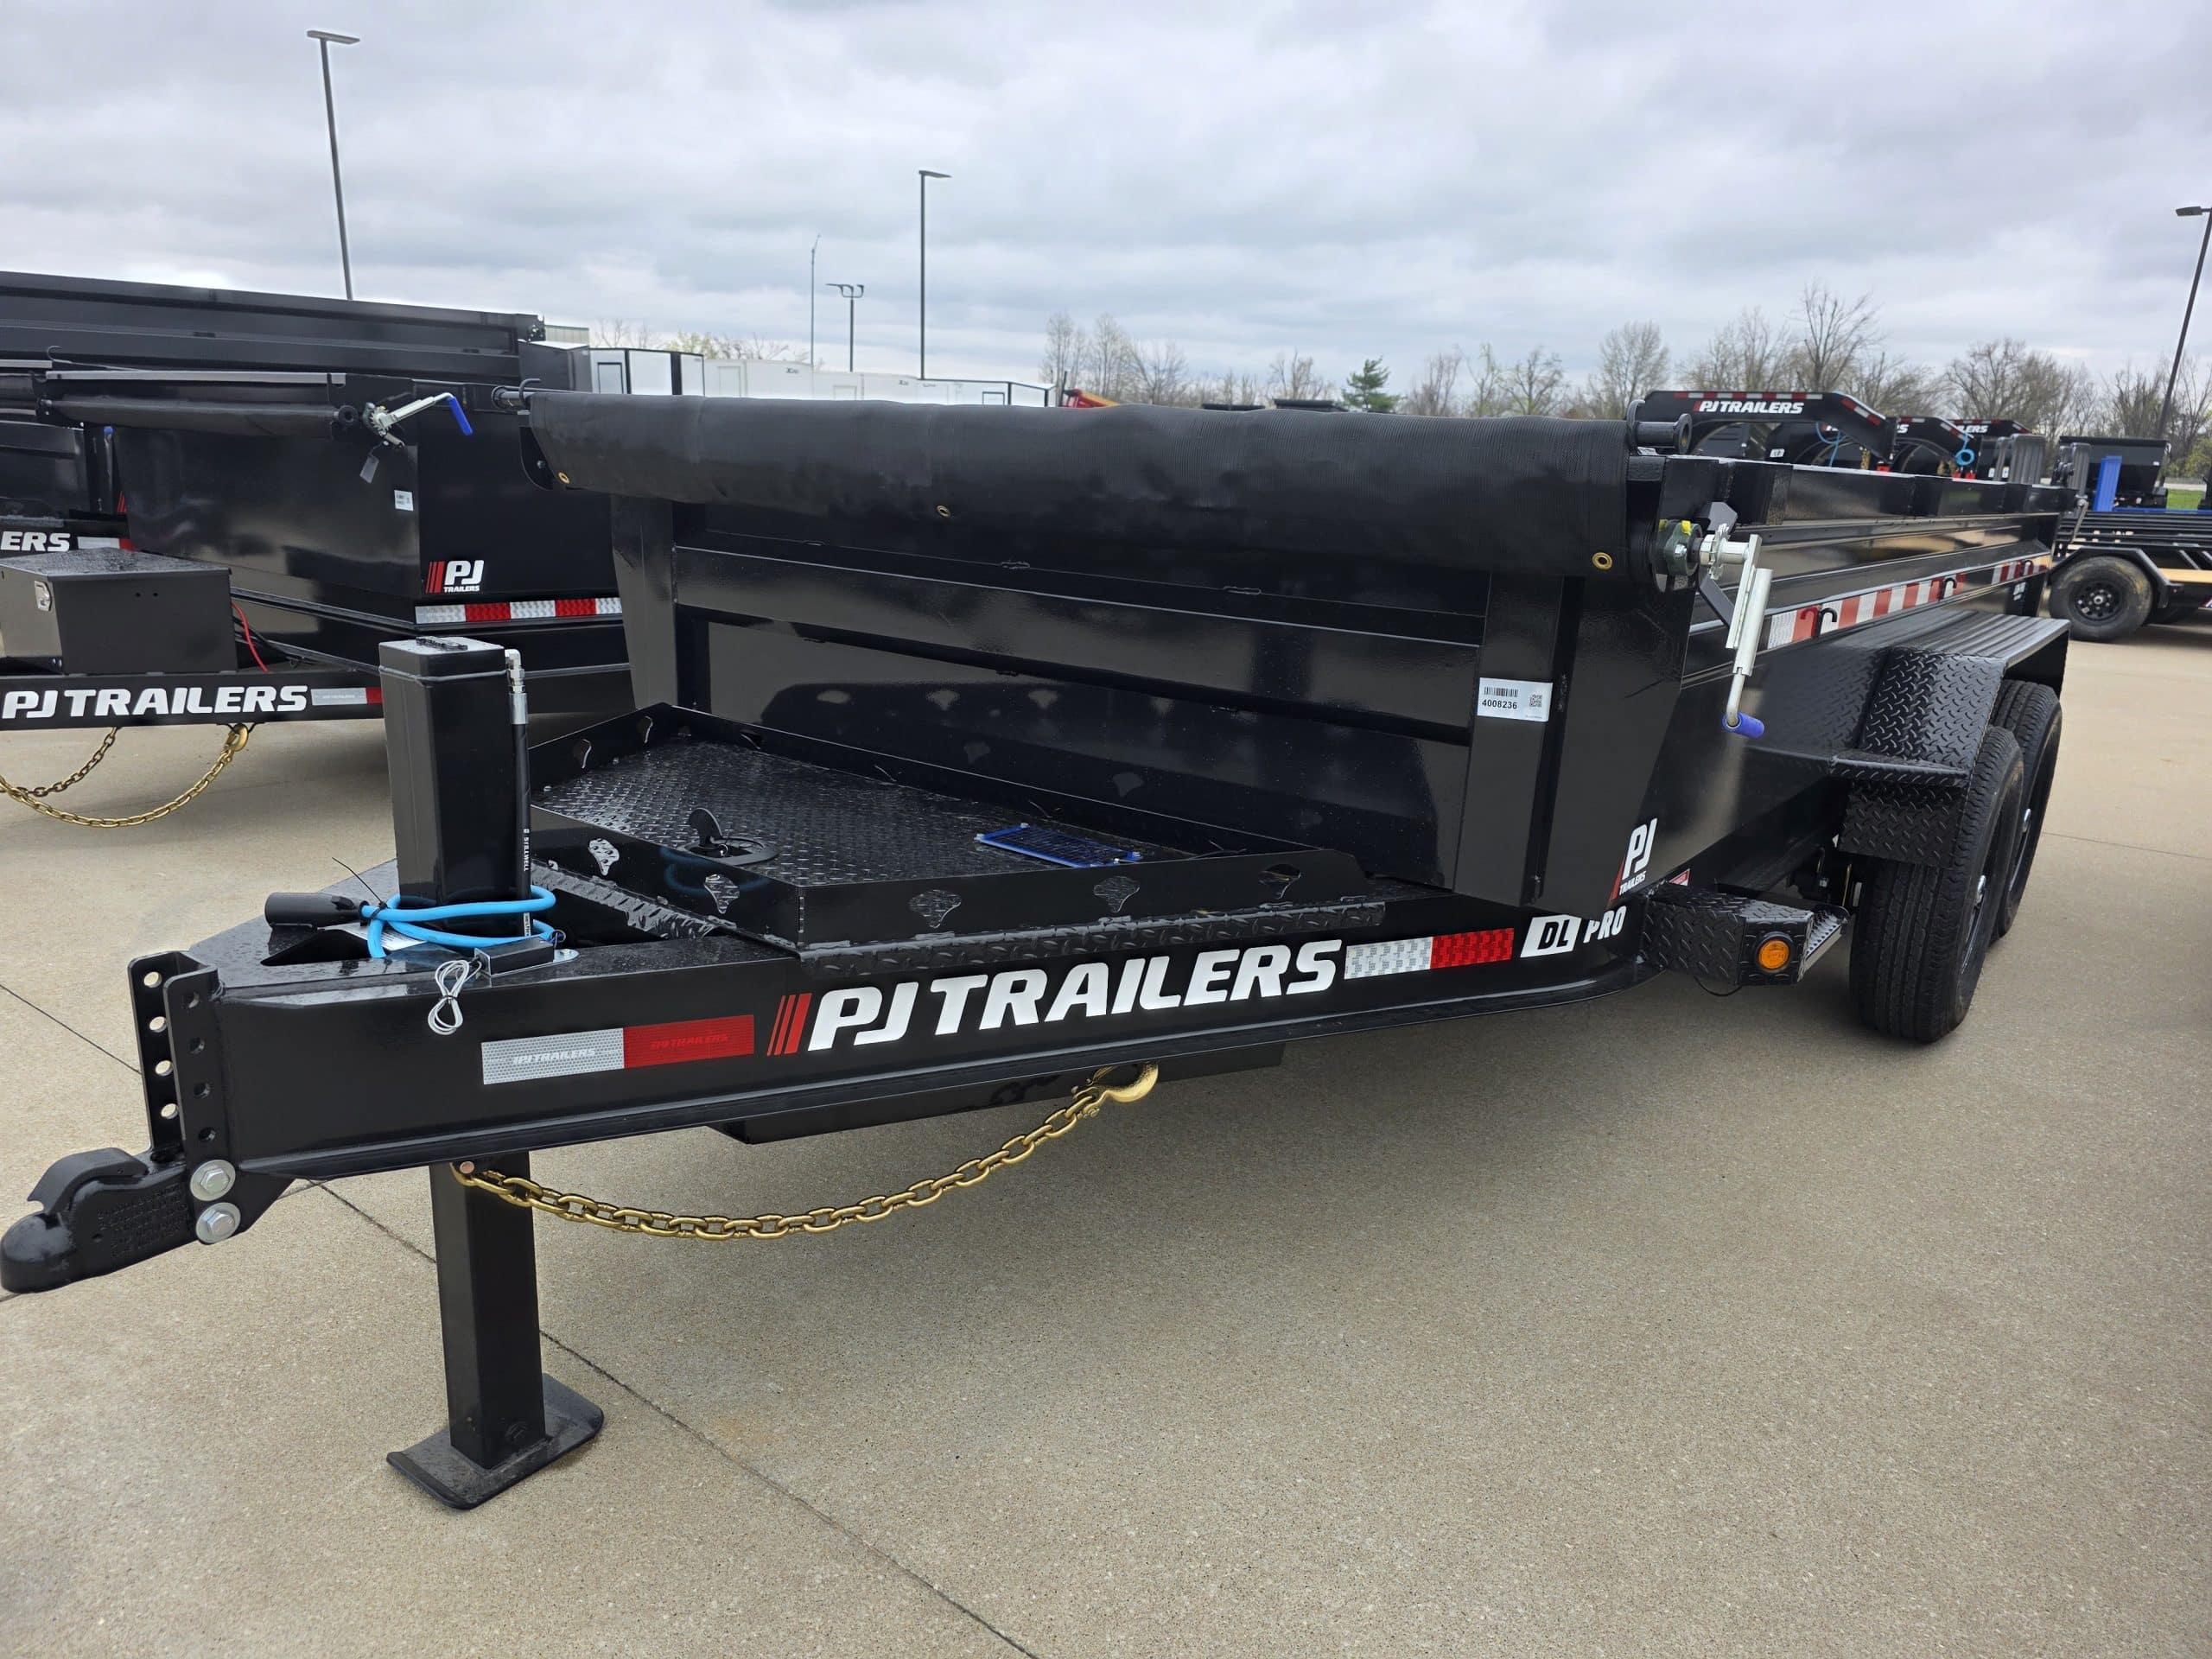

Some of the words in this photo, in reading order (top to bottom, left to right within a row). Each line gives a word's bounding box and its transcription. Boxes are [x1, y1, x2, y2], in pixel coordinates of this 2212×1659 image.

[1699, 400, 1720, 413] PJ
[1720, 401, 1805, 414] TRAILERS
[444, 560, 485, 586] PJ
[3, 690, 59, 719] PJ
[64, 686, 308, 716] TRAILERS
[1482, 698, 1518, 709] 4008236
[1622, 817, 1657, 880] PJ
[1619, 871, 1646, 896] TRAILERS
[1537, 918, 1570, 950] DL
[1583, 906, 1627, 944] PRO
[808, 982, 919, 1052] PJ
[930, 940, 1343, 1036] TRAILERS
